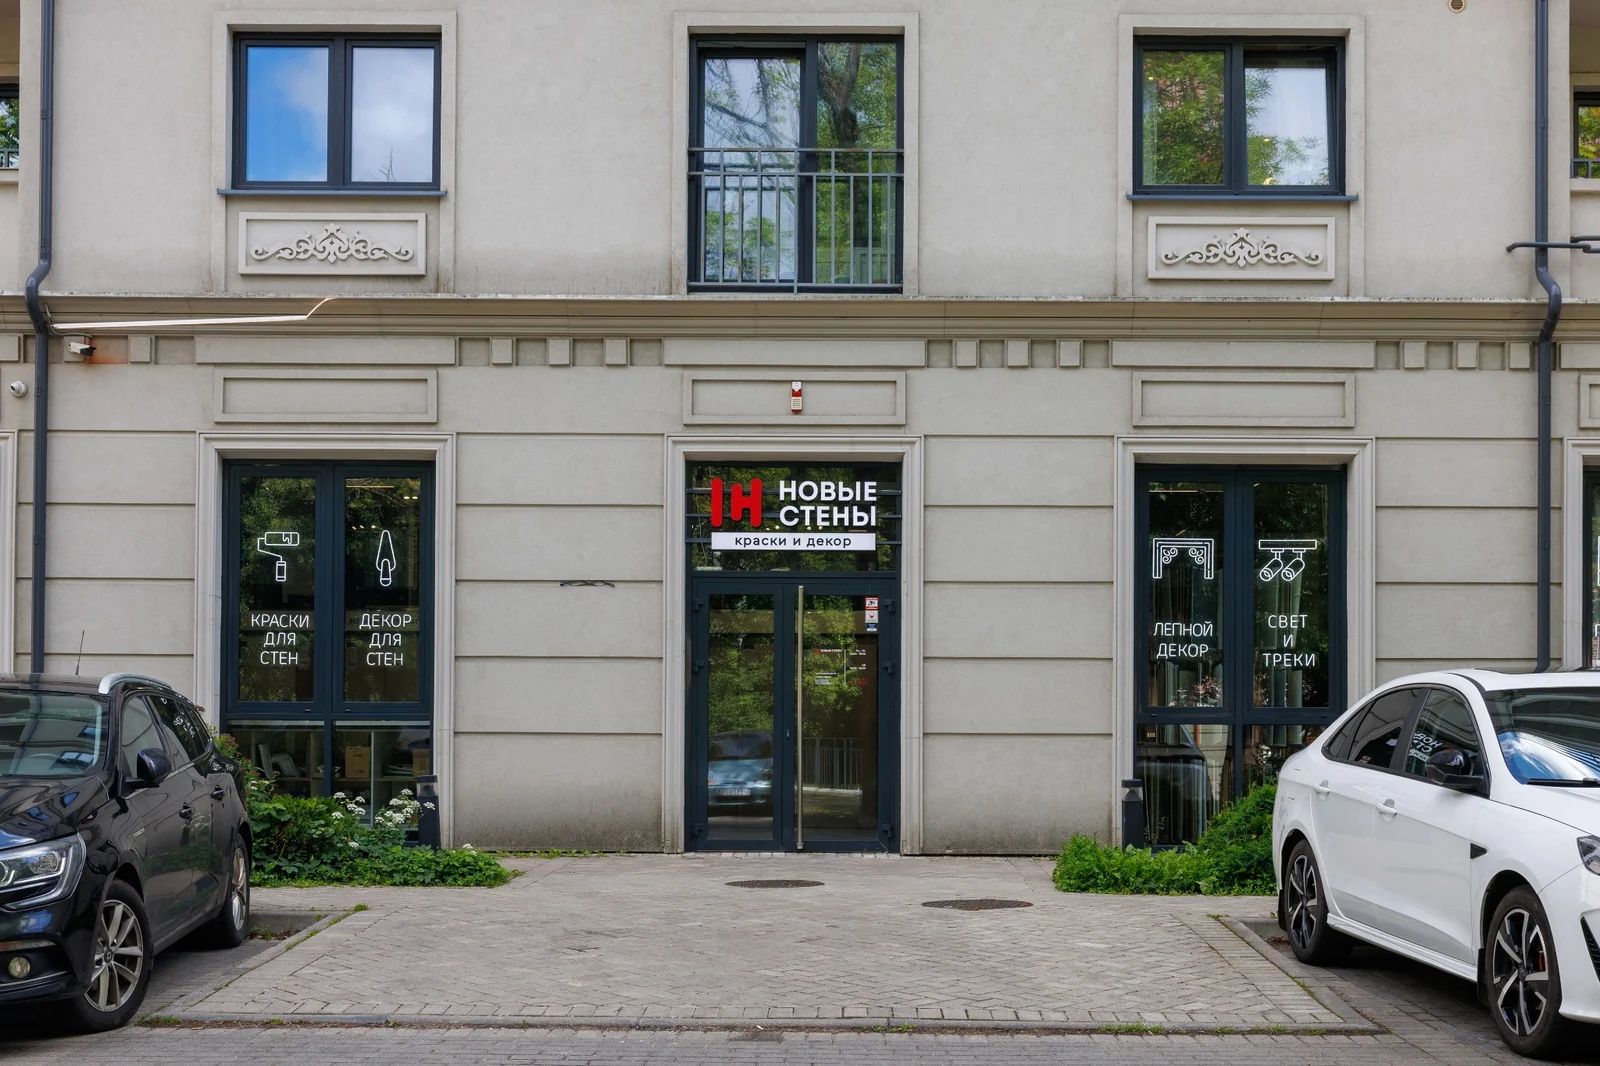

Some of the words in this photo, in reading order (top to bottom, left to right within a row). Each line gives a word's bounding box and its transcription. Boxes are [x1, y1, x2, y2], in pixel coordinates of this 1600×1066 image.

[779, 480, 877, 501] НОВЫЕ
[779, 505, 876, 526] СТЕНЫ
[735, 537, 787, 548] краски
[792, 537, 801, 546] и
[806, 537, 852, 548] декор
[251, 613, 310, 628] КРАСКИ
[358, 613, 412, 629] ДЕКОР
[1267, 614, 1308, 629] СВЕТ
[1153, 620, 1213, 637] ЛЕПНОЙ
[263, 631, 296, 647] ДЛЯ
[368, 632, 402, 648] ДЛЯ
[1283, 633, 1294, 648] И
[260, 650, 298, 665] СТЕН
[366, 651, 404, 666] СТЕН
[1156, 643, 1209, 659] ДЕКОР
[1262, 653, 1315, 667] ТРЕКИ
